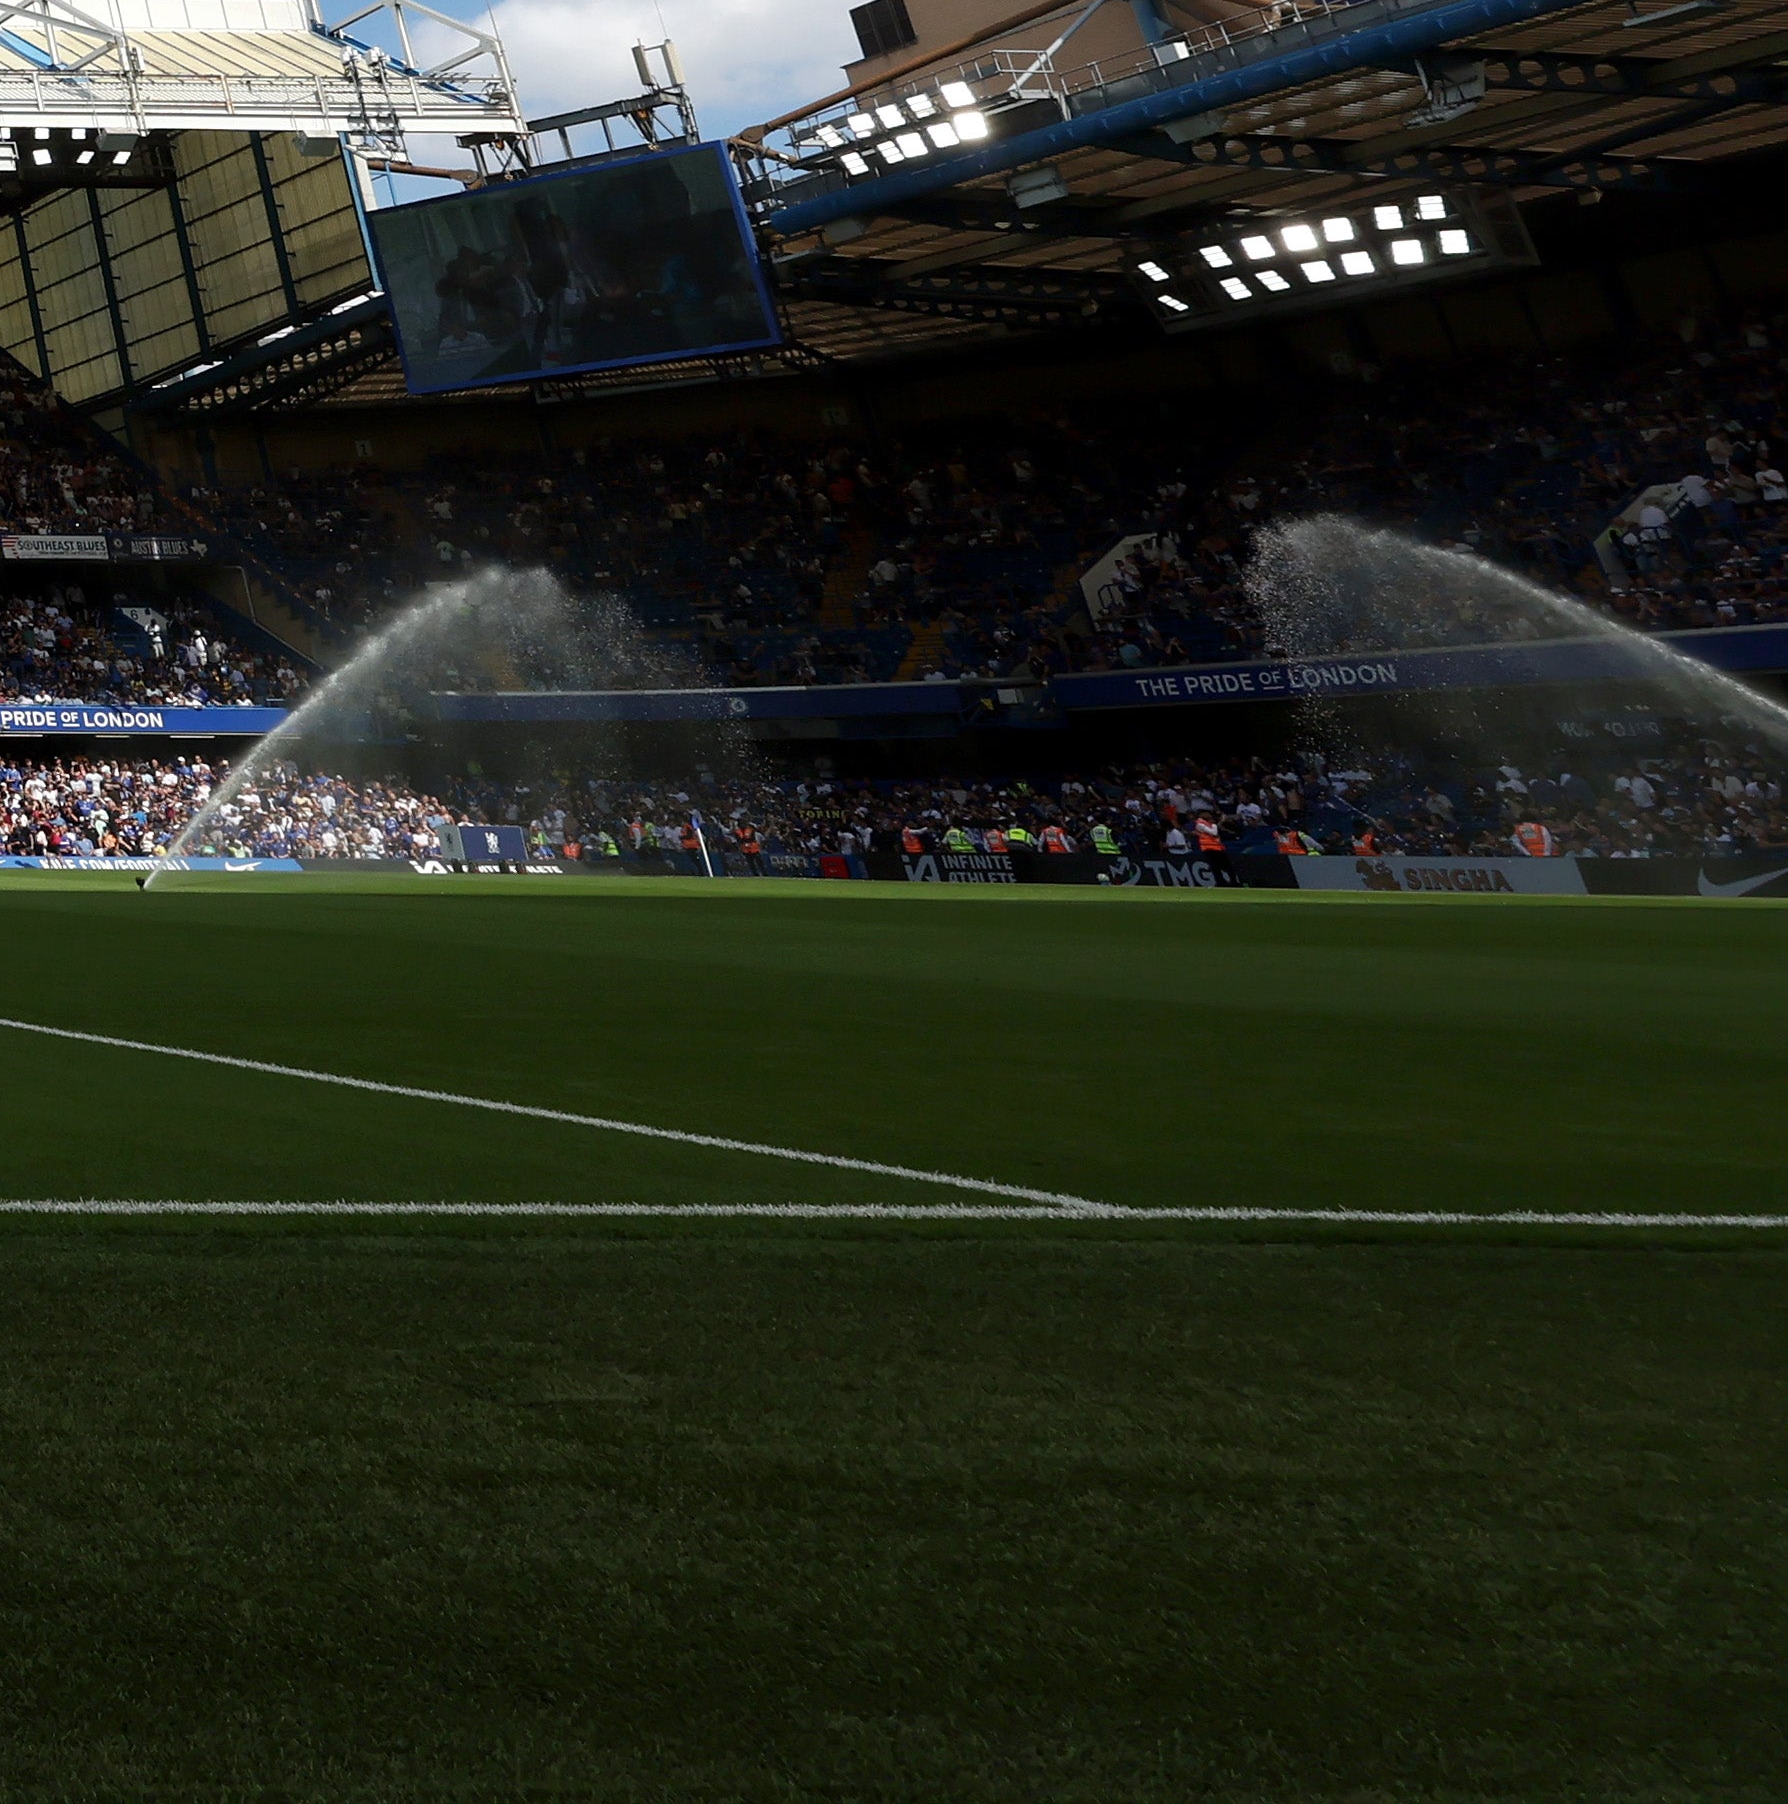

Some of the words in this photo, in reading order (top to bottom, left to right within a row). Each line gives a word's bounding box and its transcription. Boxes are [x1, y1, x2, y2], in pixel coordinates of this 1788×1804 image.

[77, 541, 107, 551] BLUES
[162, 541, 189, 555] BLUES
[1136, 677, 1180, 696] THE
[1185, 673, 1255, 695] PRIDE
[1258, 670, 1282, 689] OF
[1288, 664, 1398, 689] LONDON
[1, 711, 57, 727] PRIDE
[61, 711, 80, 726] OF
[83, 712, 163, 728] LONDON
[942, 854, 1013, 870] INFINITE
[1144, 860, 1217, 887] TMG
[1403, 868, 1514, 893] SINGHA
